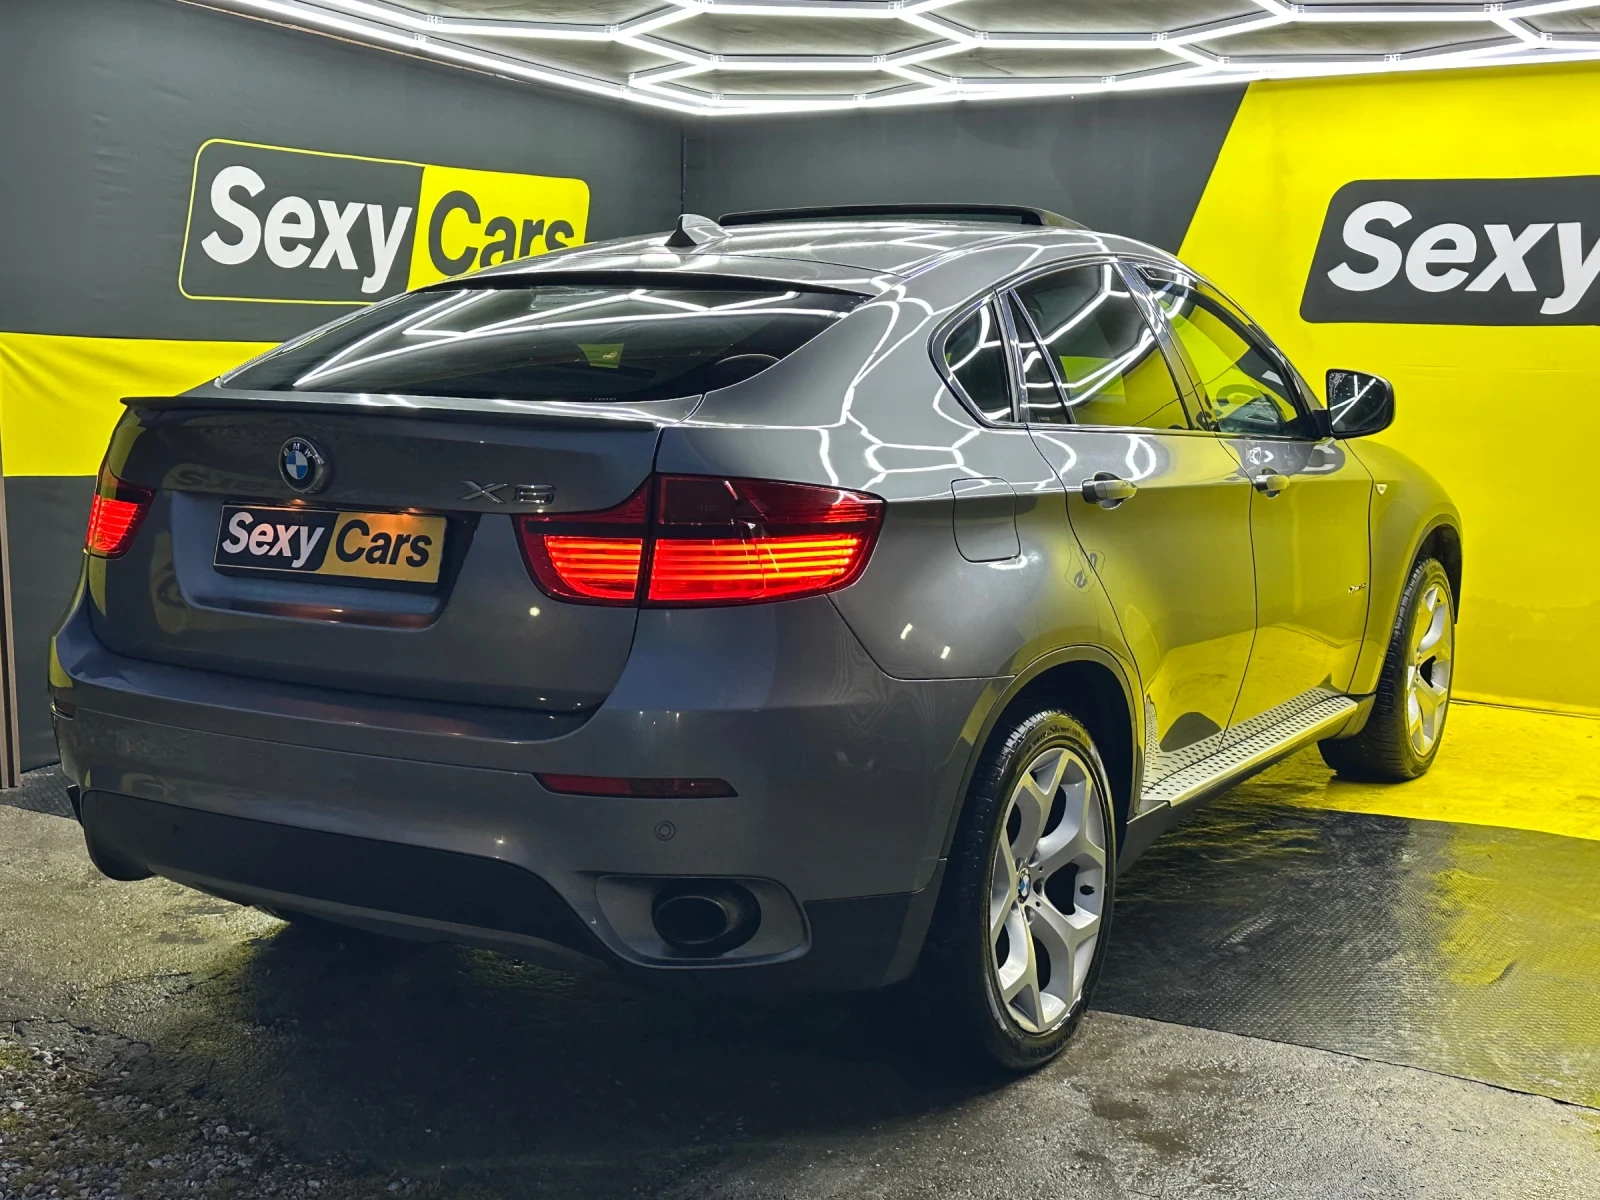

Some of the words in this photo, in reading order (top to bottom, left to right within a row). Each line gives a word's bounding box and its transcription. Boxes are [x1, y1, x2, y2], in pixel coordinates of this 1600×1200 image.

[201, 166, 412, 294] Sexy
[1327, 200, 1600, 315] Sexy
[283, 442, 313, 458] BMW
[222, 511, 325, 568] Sexy
[335, 519, 433, 568] Cars
